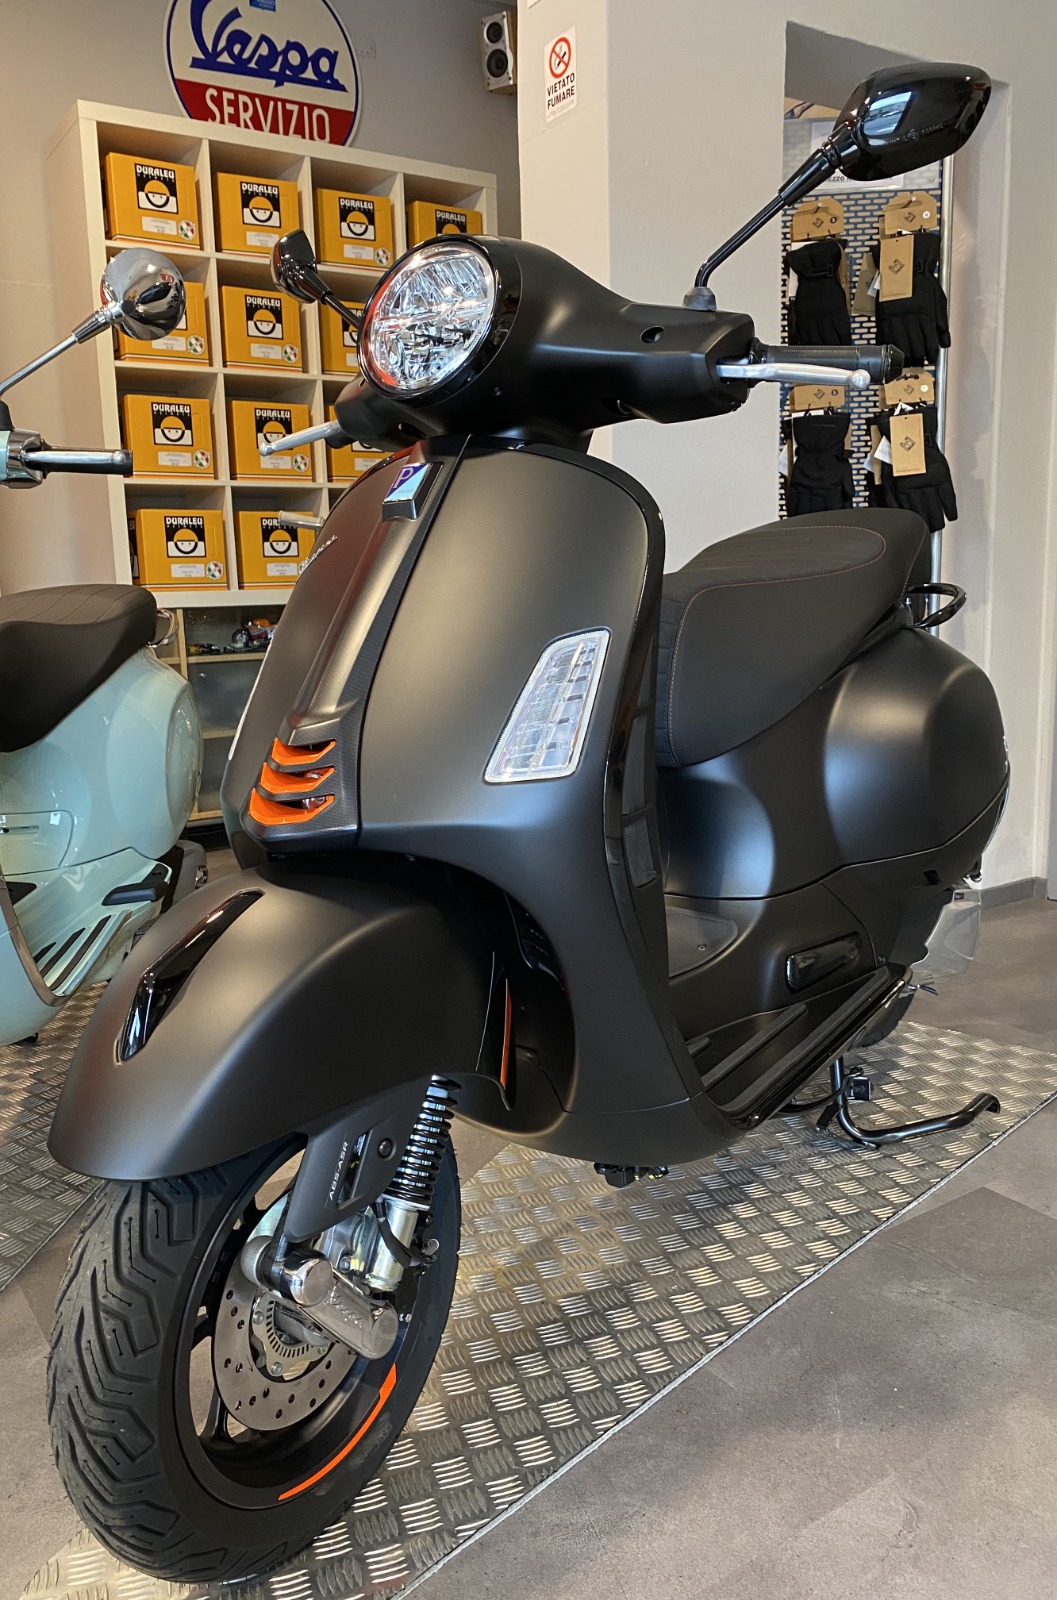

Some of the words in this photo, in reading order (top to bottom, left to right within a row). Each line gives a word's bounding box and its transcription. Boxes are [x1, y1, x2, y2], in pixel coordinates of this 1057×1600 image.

[189, 0, 348, 92] Vespa
[547, 73, 575, 96] VIETATO
[547, 85, 575, 109] FUMARE
[205, 87, 330, 143] SERVIZIO
[136, 165, 175, 179] DURALEU
[241, 183, 278, 194] DURALEU
[340, 198, 373, 209] DURALEU
[246, 296, 280, 307] DURALEU
[152, 403, 190, 413] DURALEU
[256, 409, 290, 418] DURALEU
[165, 517, 203, 525] DURALEU
